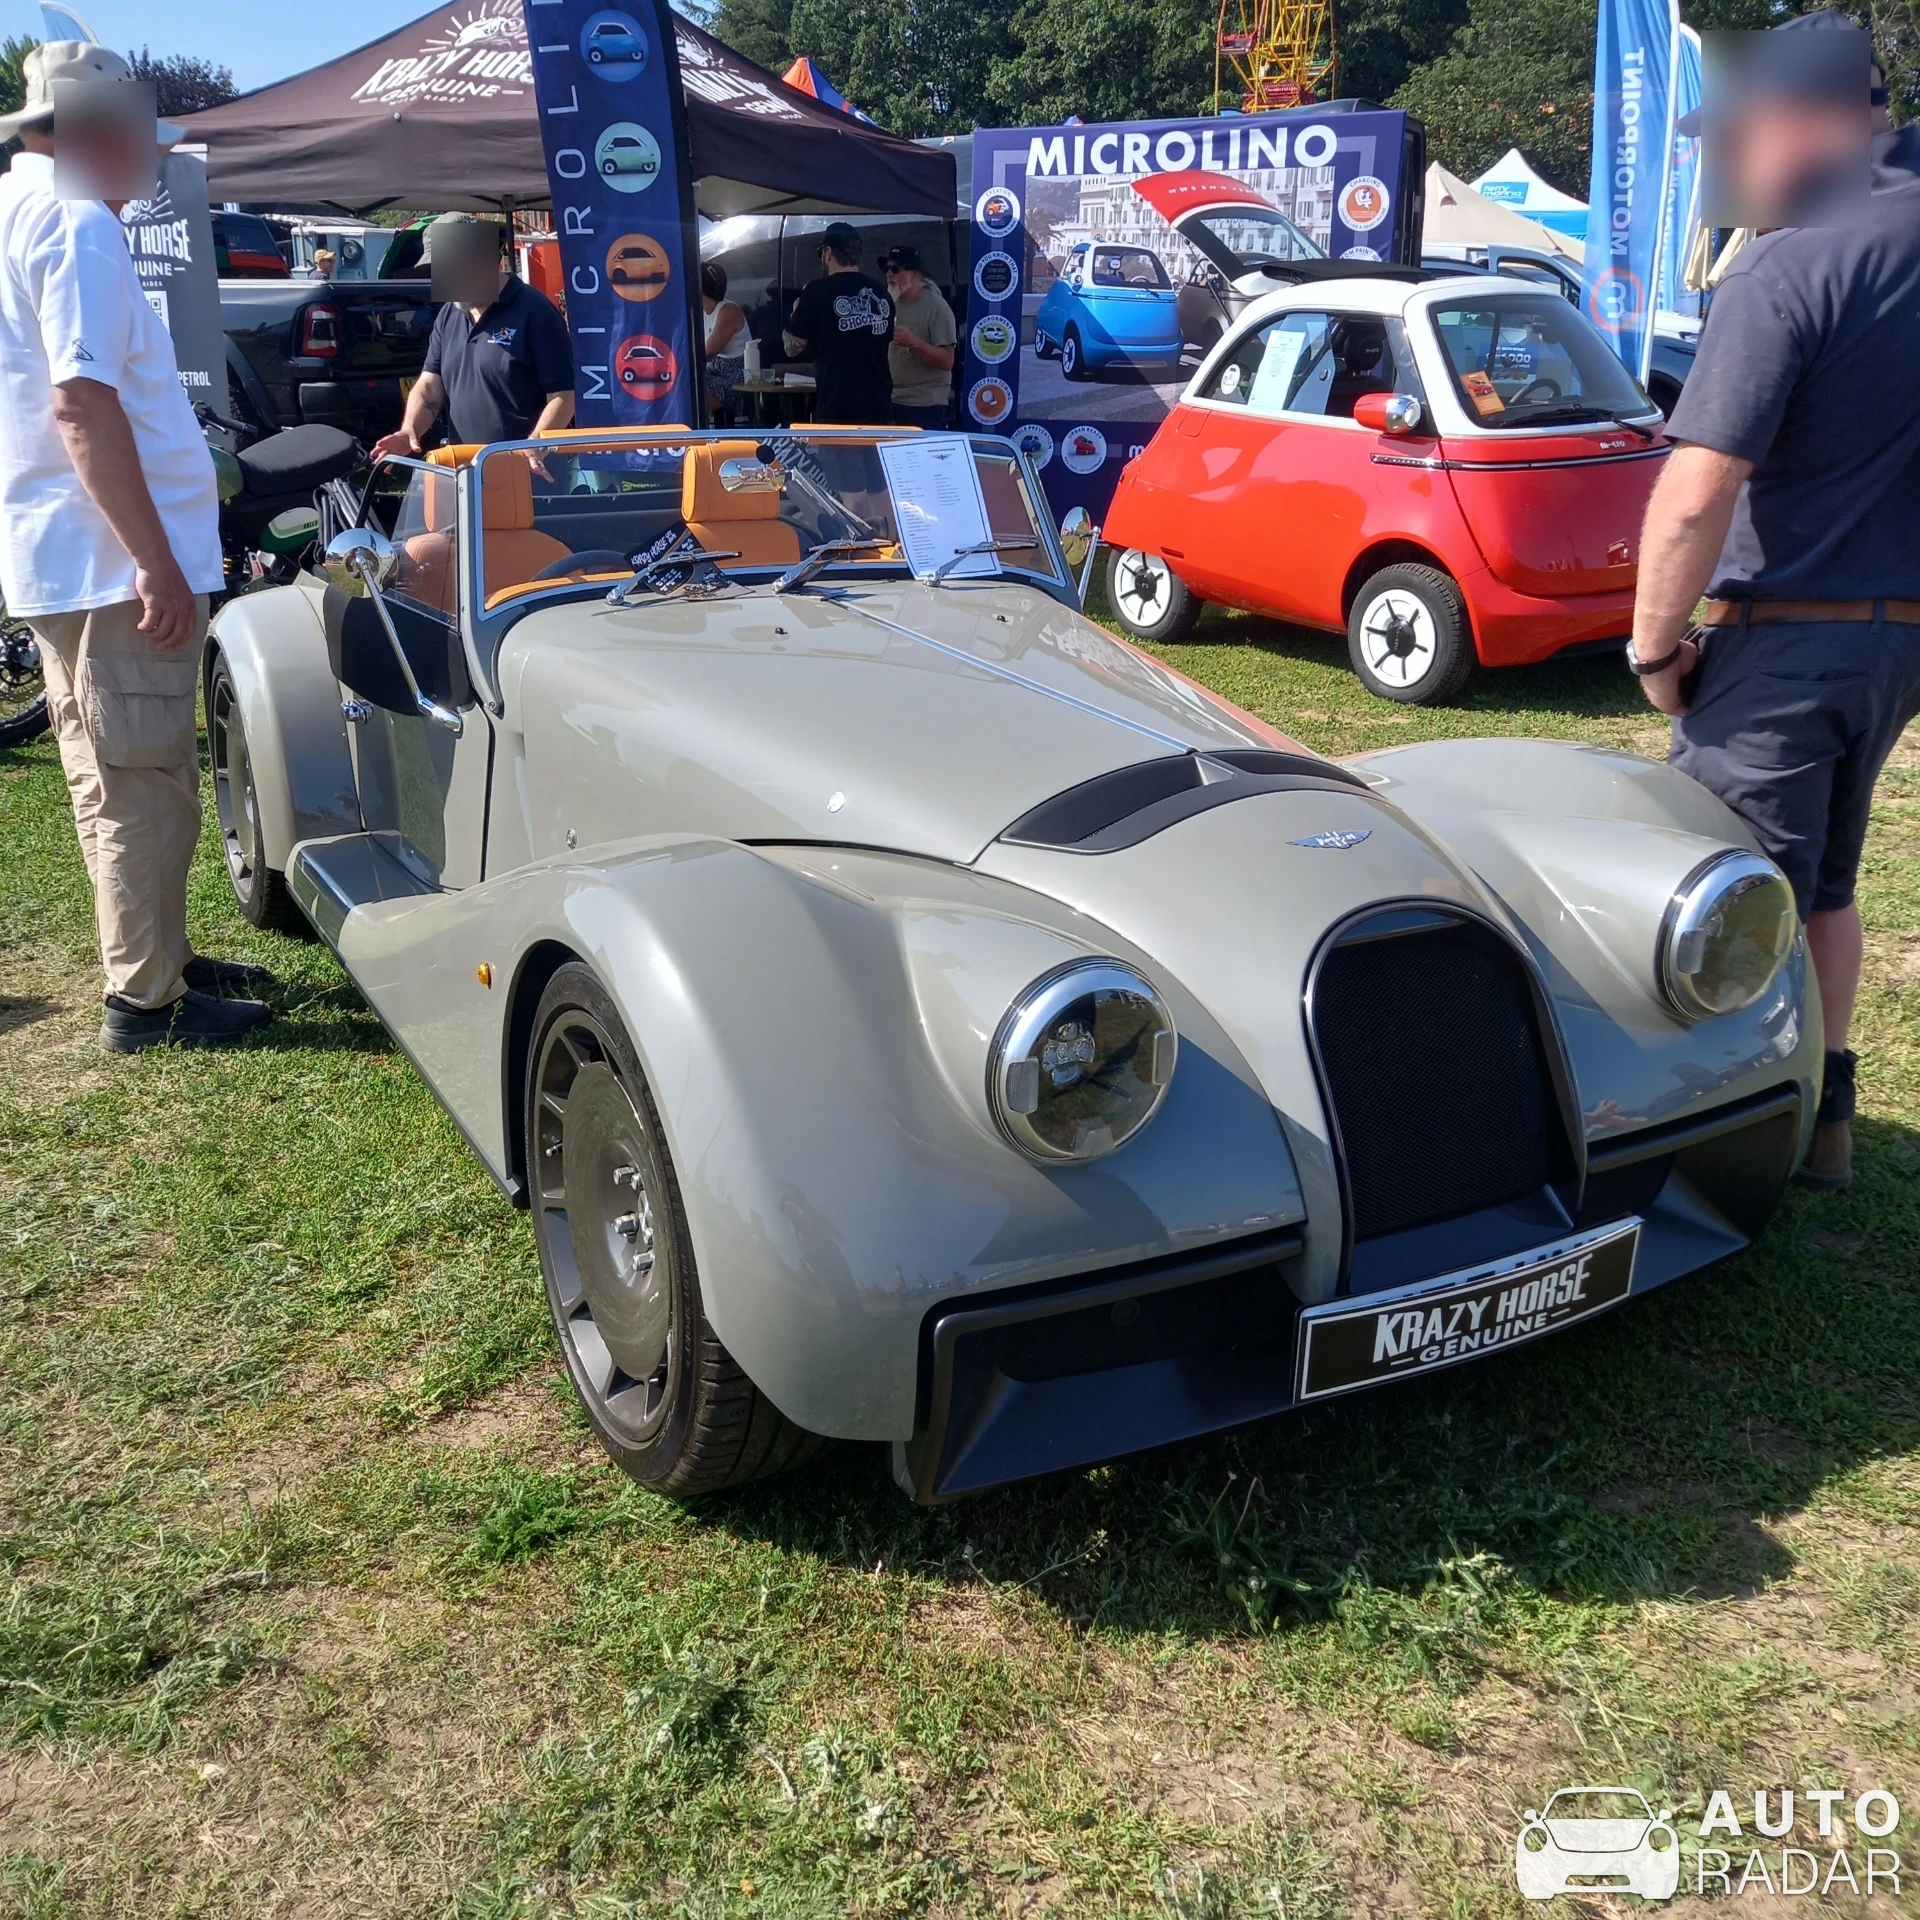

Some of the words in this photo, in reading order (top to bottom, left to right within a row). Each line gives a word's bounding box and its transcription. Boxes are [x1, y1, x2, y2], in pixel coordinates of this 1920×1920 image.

[350, 48, 473, 100] KRAZY
[380, 78, 501, 103] GENUINE
[1026, 124, 1338, 176] MICROLINO
[986, 188, 1011, 197] CREATION
[1350, 178, 1380, 188] CHARGING
[531, 0, 611, 400] MICROLI
[140, 218, 193, 263] HORSE
[134, 260, 173, 276] UINE
[982, 254, 992, 263] YOU
[1008, 259, 1017, 273] THAT
[838, 313, 876, 332] SHOOT
[872, 320, 888, 335] HIP
[976, 316, 1012, 330] ENVIRONMENT
[177, 371, 212, 386] PETROL
[970, 380, 986, 399] PERFECT
[998, 381, 1012, 400] TOWING
[1011, 427, 1027, 441] THOLE
[1029, 426, 1052, 449] PREVENTION
[1068, 428, 1085, 439] URBAN
[1087, 428, 1102, 440] READY
[630, 552, 652, 566] KRAZY
[650, 536, 668, 558] HORSE
[1372, 1296, 1492, 1364] KRAZY
[1498, 1252, 1594, 1323] HORSE
[1418, 1312, 1548, 1363] GENUINE
